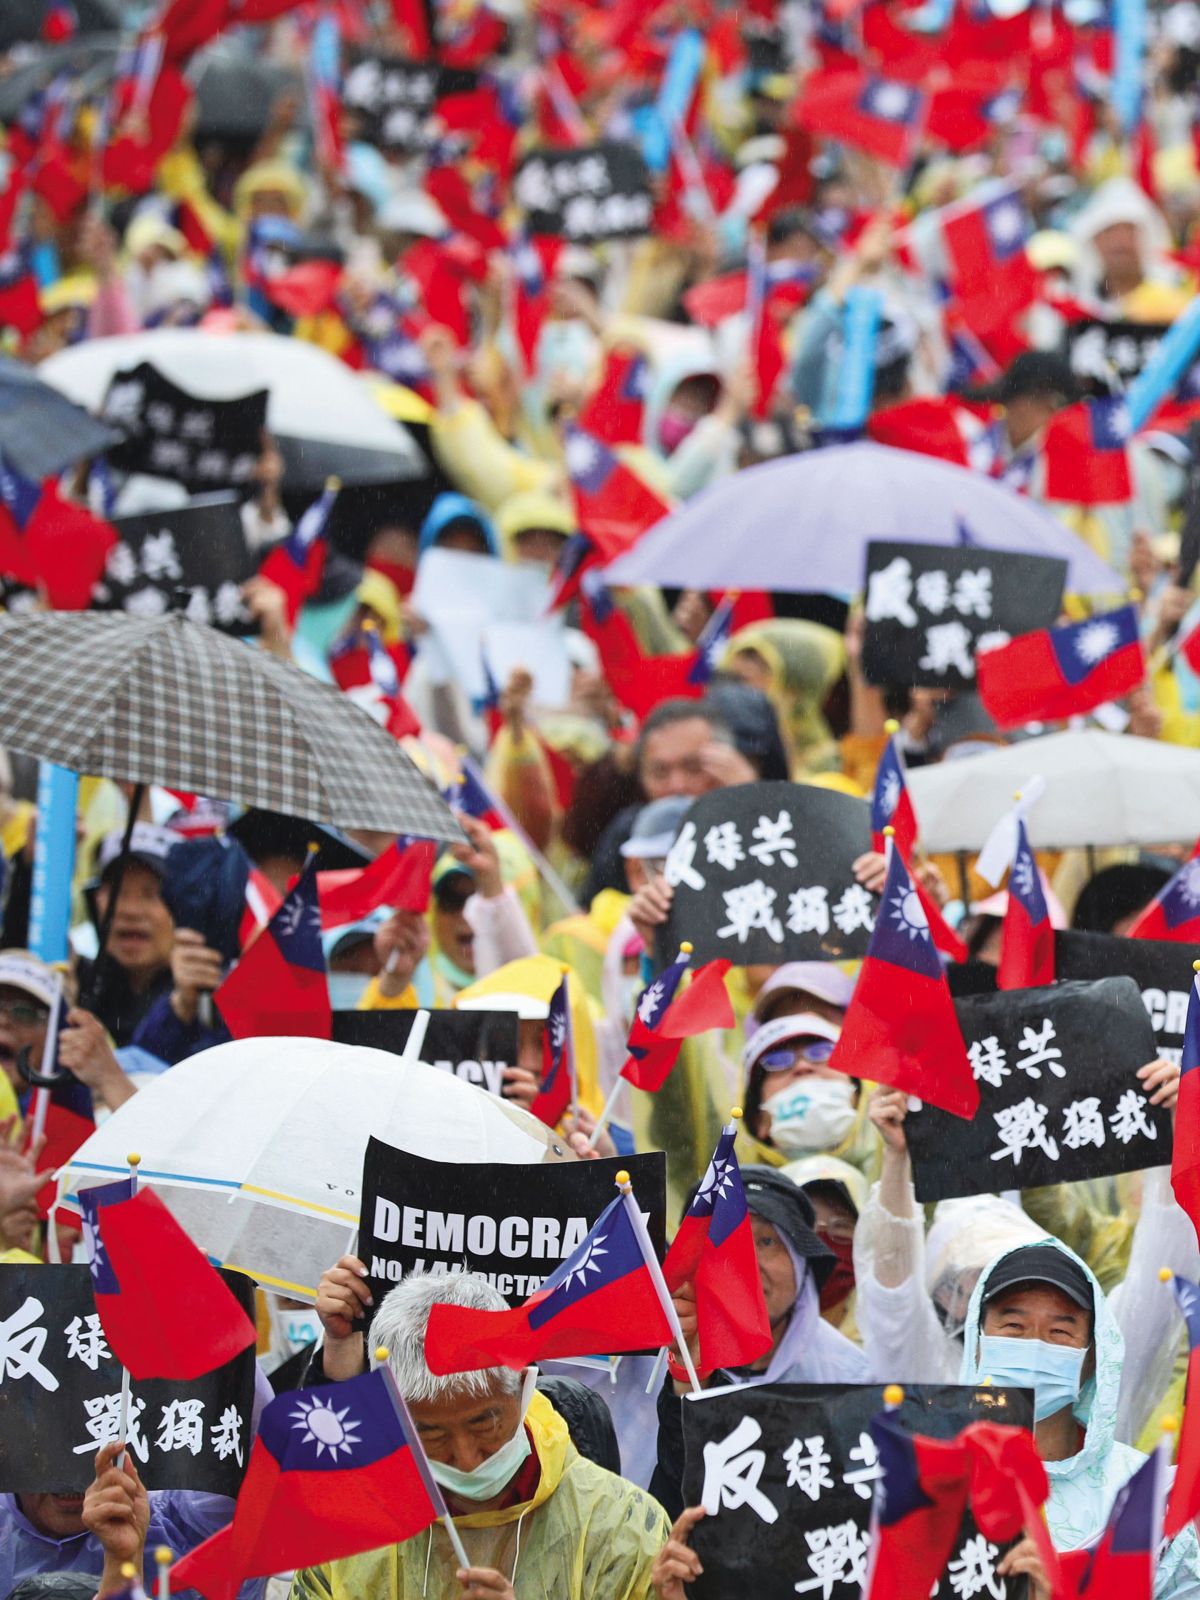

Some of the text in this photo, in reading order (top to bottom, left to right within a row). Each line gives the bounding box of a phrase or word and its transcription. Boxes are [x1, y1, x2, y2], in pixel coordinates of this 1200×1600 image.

[990, 1089, 1157, 1165] 戰獨裁
[373, 1195, 650, 1259] DEMOCRA
[371, 1255, 402, 1282] NO
[0, 1296, 113, 1392] 反綠
[72, 1390, 243, 1468] 戰獨裁
[794, 1519, 1006, 1600] 戰裁
